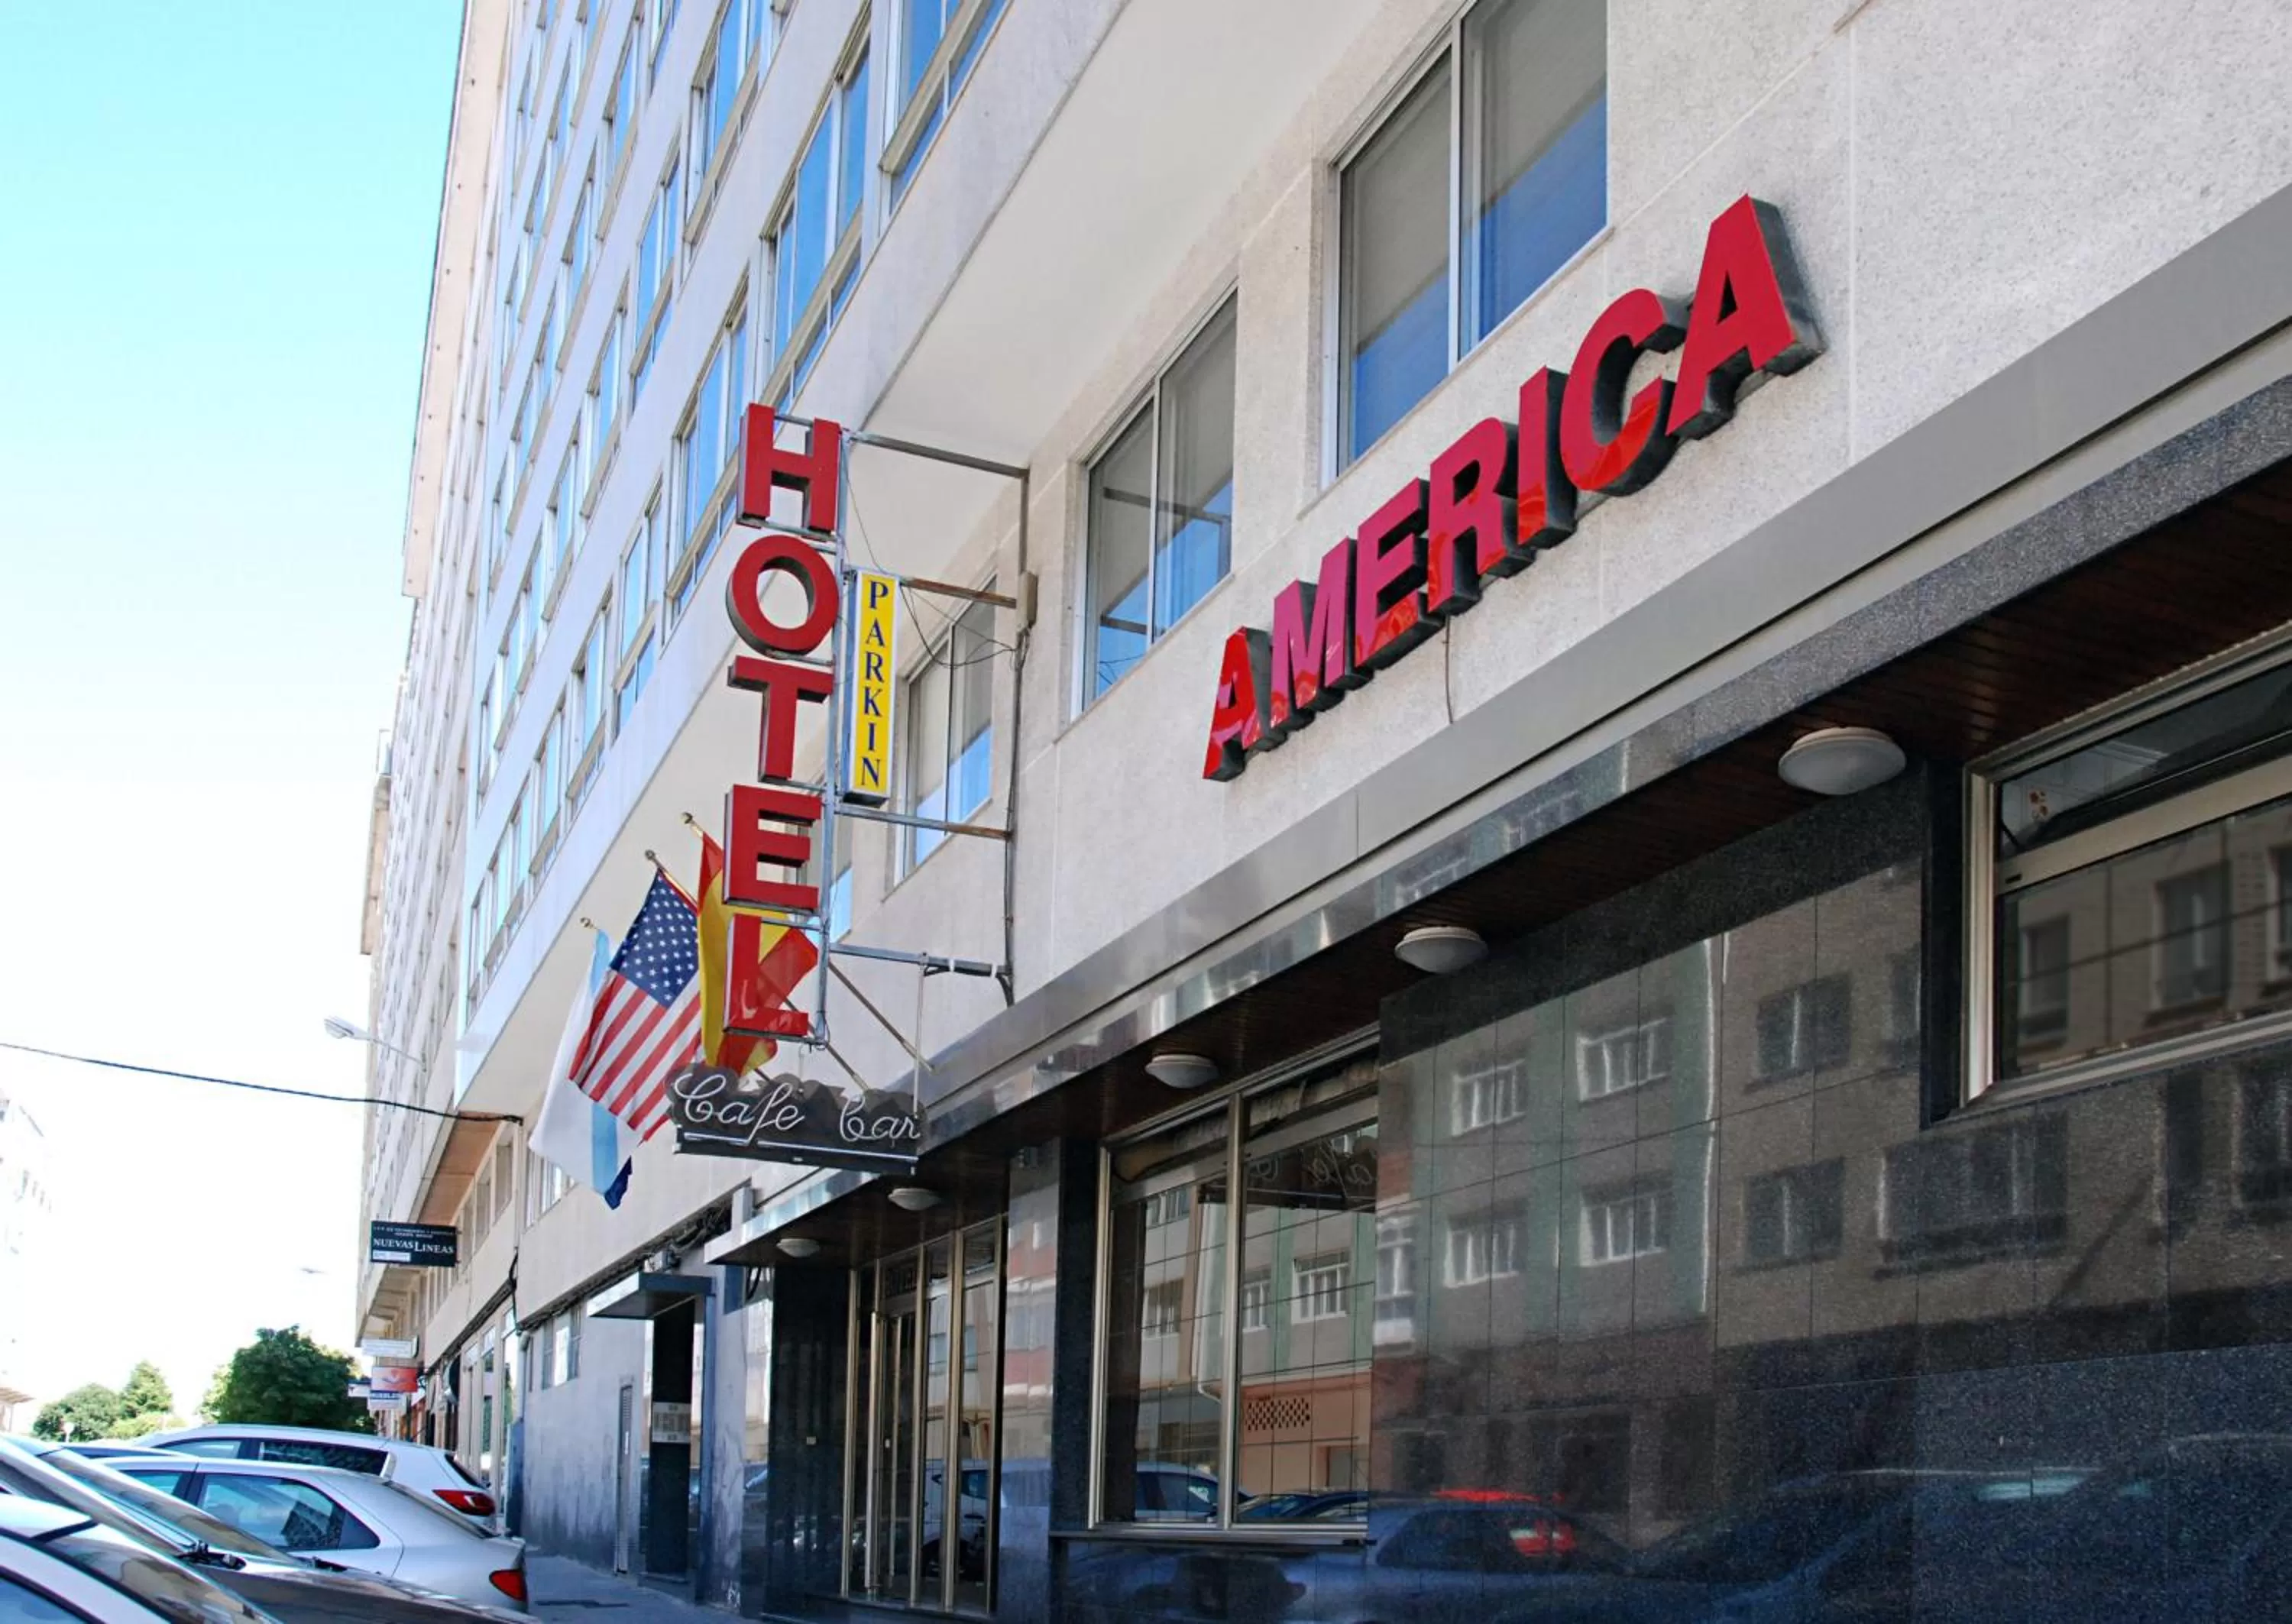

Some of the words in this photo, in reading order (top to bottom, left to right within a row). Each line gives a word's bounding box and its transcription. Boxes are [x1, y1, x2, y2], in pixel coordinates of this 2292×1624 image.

[724, 403, 841, 1037] HOTEL
[860, 579, 889, 788] PARKIN
[1203, 192, 1823, 783] AMERICA
